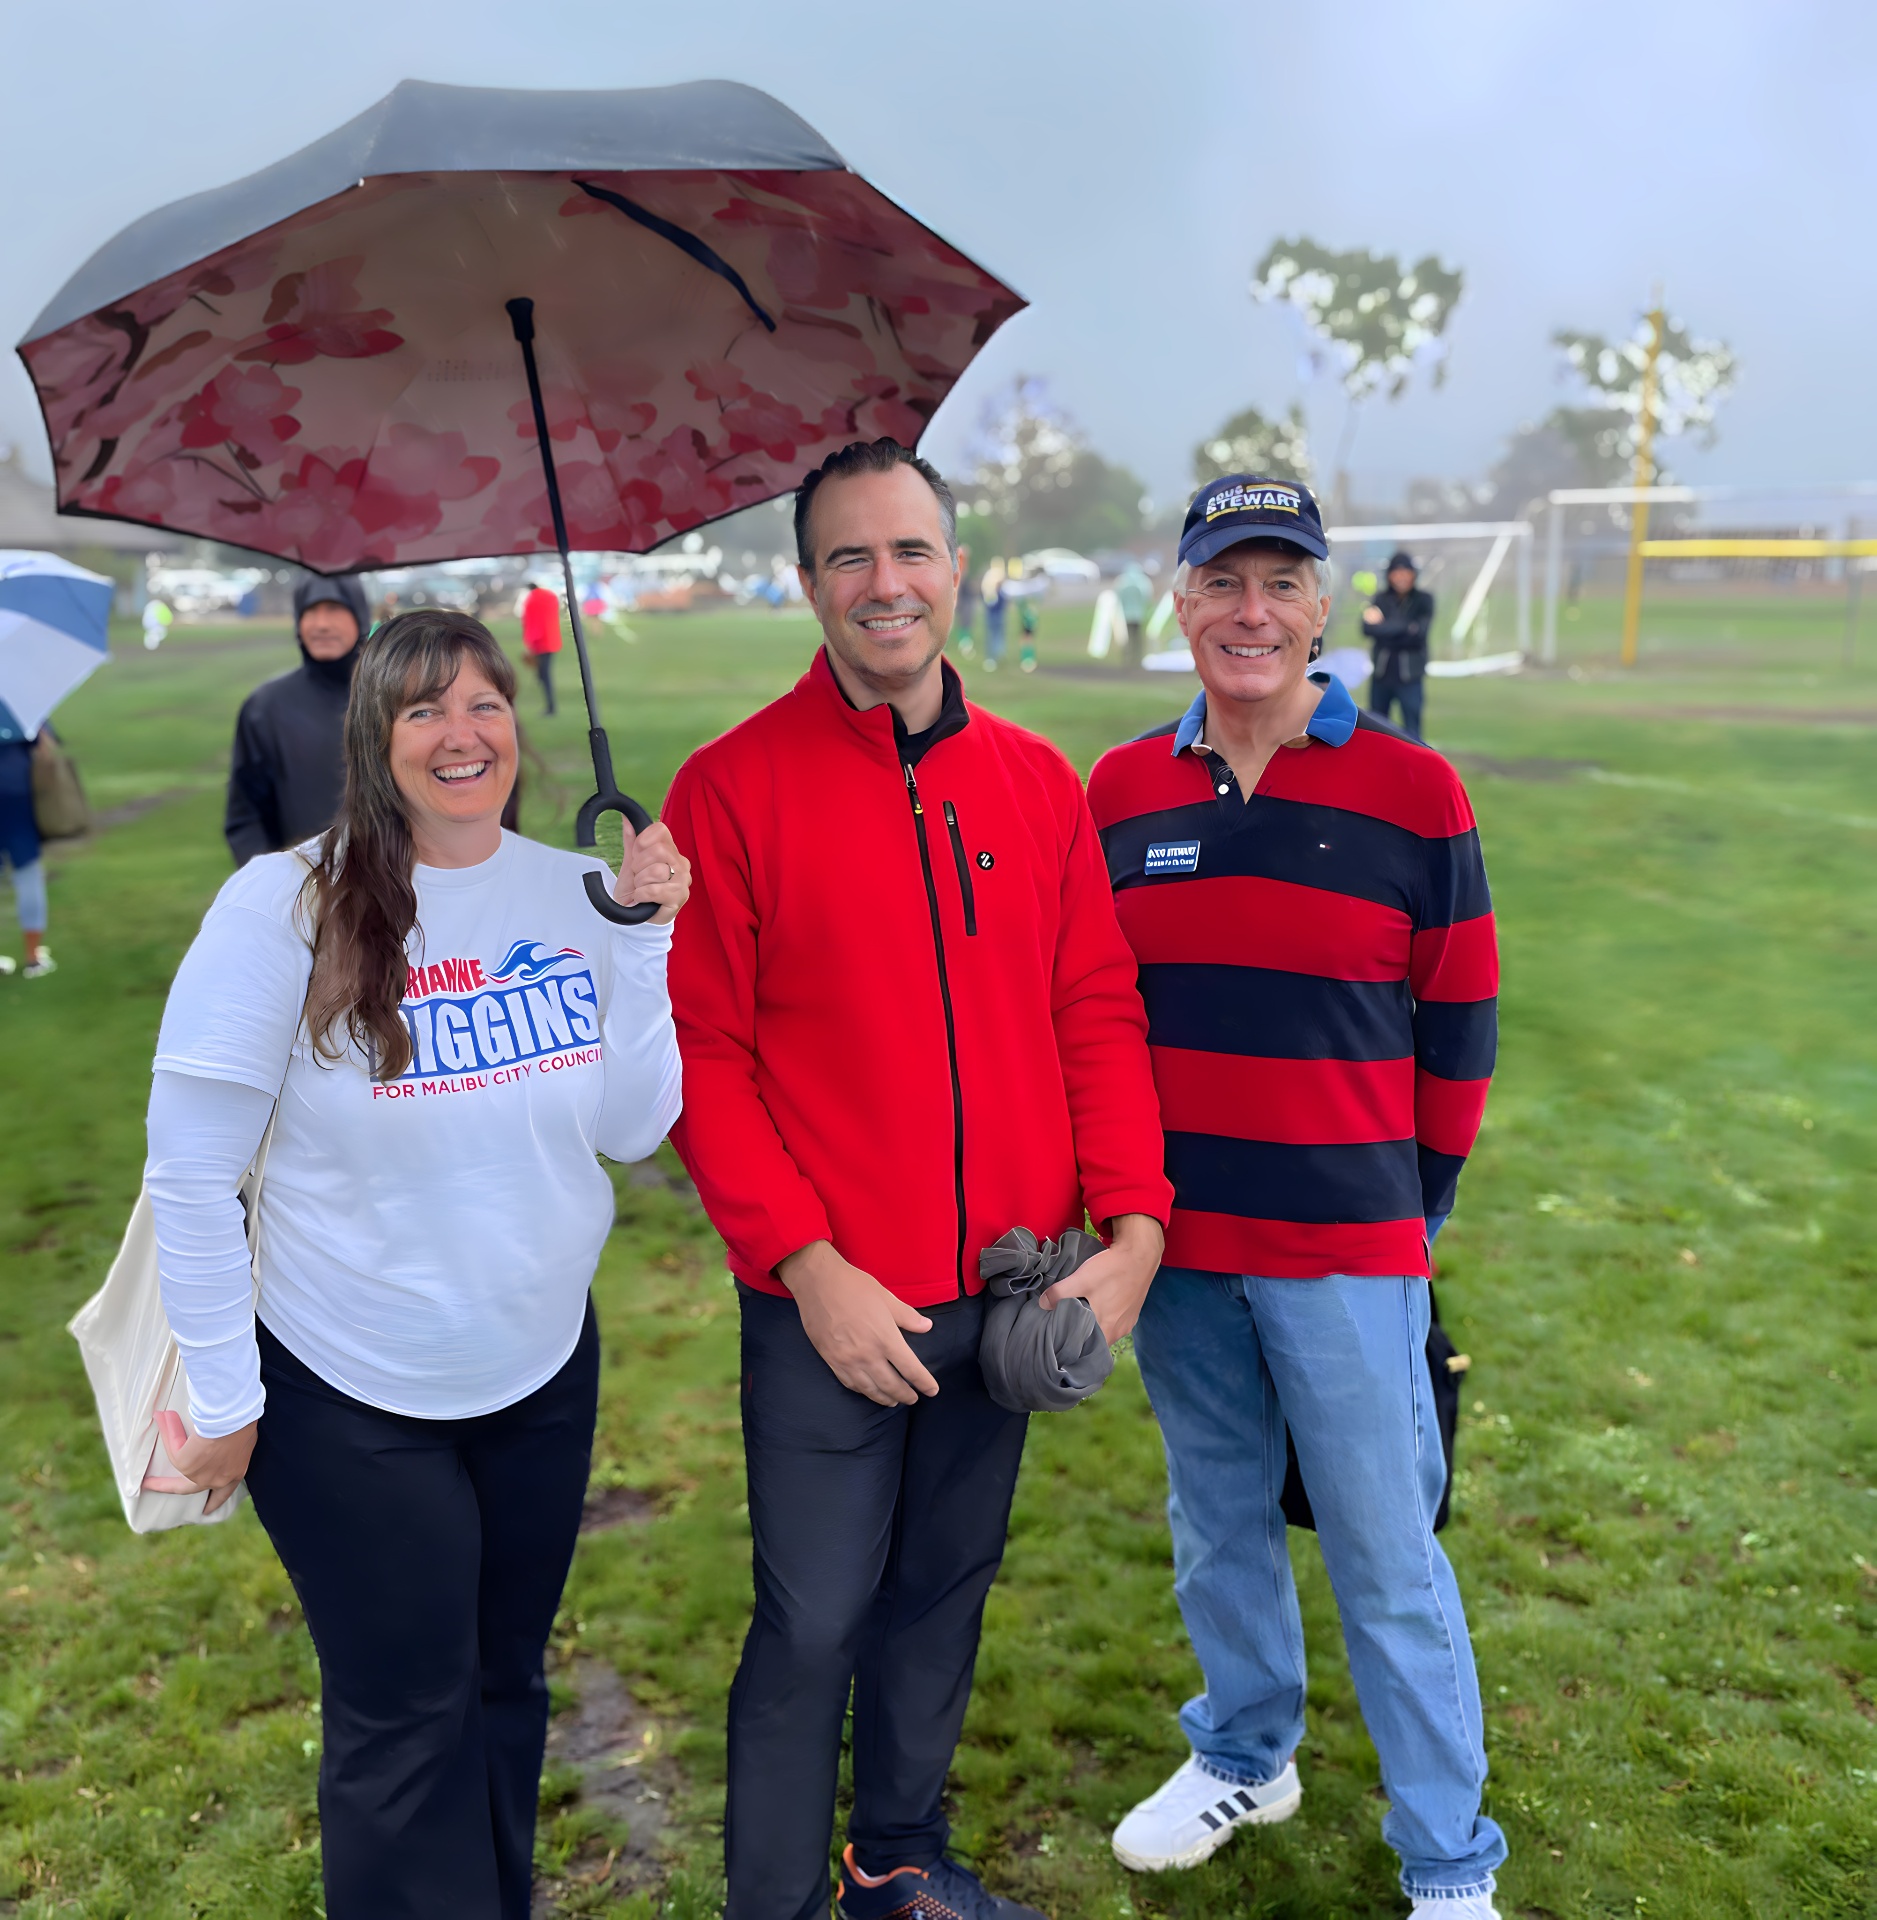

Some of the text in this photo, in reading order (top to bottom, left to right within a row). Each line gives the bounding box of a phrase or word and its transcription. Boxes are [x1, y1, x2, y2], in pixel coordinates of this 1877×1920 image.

[1206, 492, 1301, 515] STEWART
[405, 958, 487, 998] RIANNE
[373, 1084, 415, 1099] FOR
[422, 1073, 487, 1096] MALIBU
[493, 1063, 531, 1085] CITY
